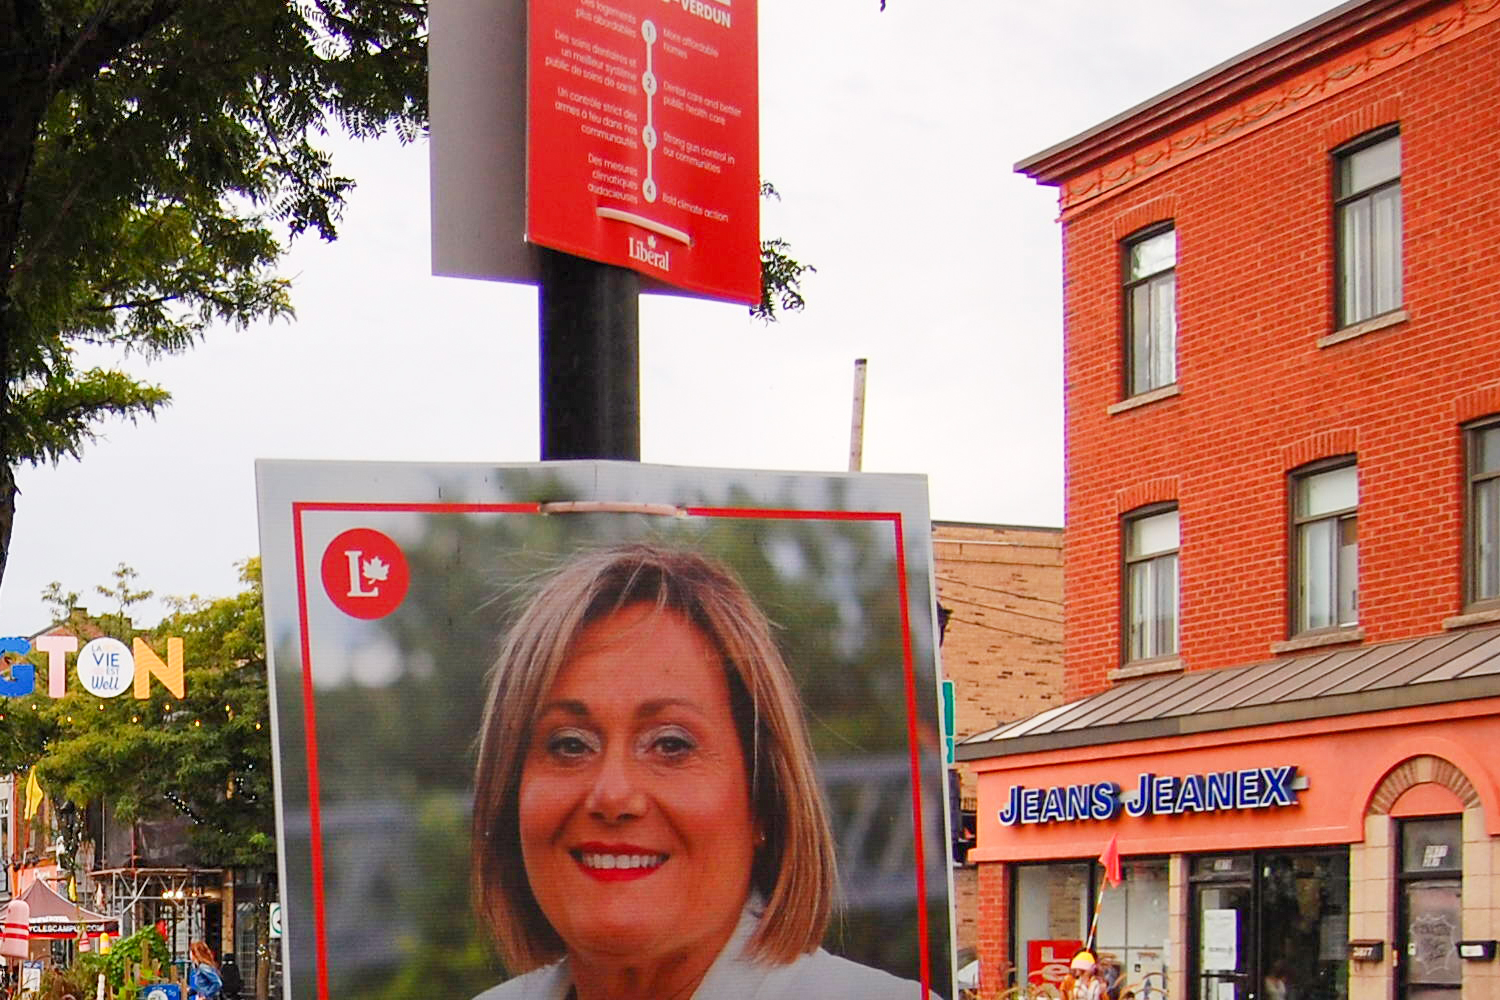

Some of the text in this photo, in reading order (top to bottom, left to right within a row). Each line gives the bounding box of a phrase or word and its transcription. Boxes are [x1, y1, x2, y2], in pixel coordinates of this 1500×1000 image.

[593, 14, 636, 38] abordables
[555, 29, 569, 43] Des
[571, 37, 591, 51] soins
[592, 44, 628, 64] dentaires
[663, 28, 719, 58] More affordable
[663, 42, 688, 59] homes
[545, 56, 570, 72] public
[571, 65, 582, 76] de
[583, 70, 603, 84] soins
[604, 77, 615, 88] de
[573, 52, 603, 69] meilleur
[604, 63, 637, 81] système
[558, 86, 569, 98] Un
[603, 102, 622, 117] strict
[623, 109, 638, 122] des
[663, 80, 742, 118] Dental care and better
[663, 96, 726, 126] public health care
[555, 101, 580, 117] armes
[589, 110, 602, 123] feu
[602, 117, 623, 130] dans
[624, 124, 638, 136] nos
[663, 131, 686, 151] Strong
[686, 141, 700, 153] gun
[700, 146, 727, 163] control
[663, 147, 721, 174] our communities
[588, 152, 638, 177] Des mesures
[587, 183, 638, 205] audacieuses
[592, 169, 638, 191] climatiques
[662, 192, 729, 223] Bold climate action
[628, 236, 669, 272] Liberal
[91, 644, 102, 652] LA
[93, 653, 120, 667] VIE
[91, 676, 119, 690] Well
[999, 765, 1294, 827] JEANS JEANEX
